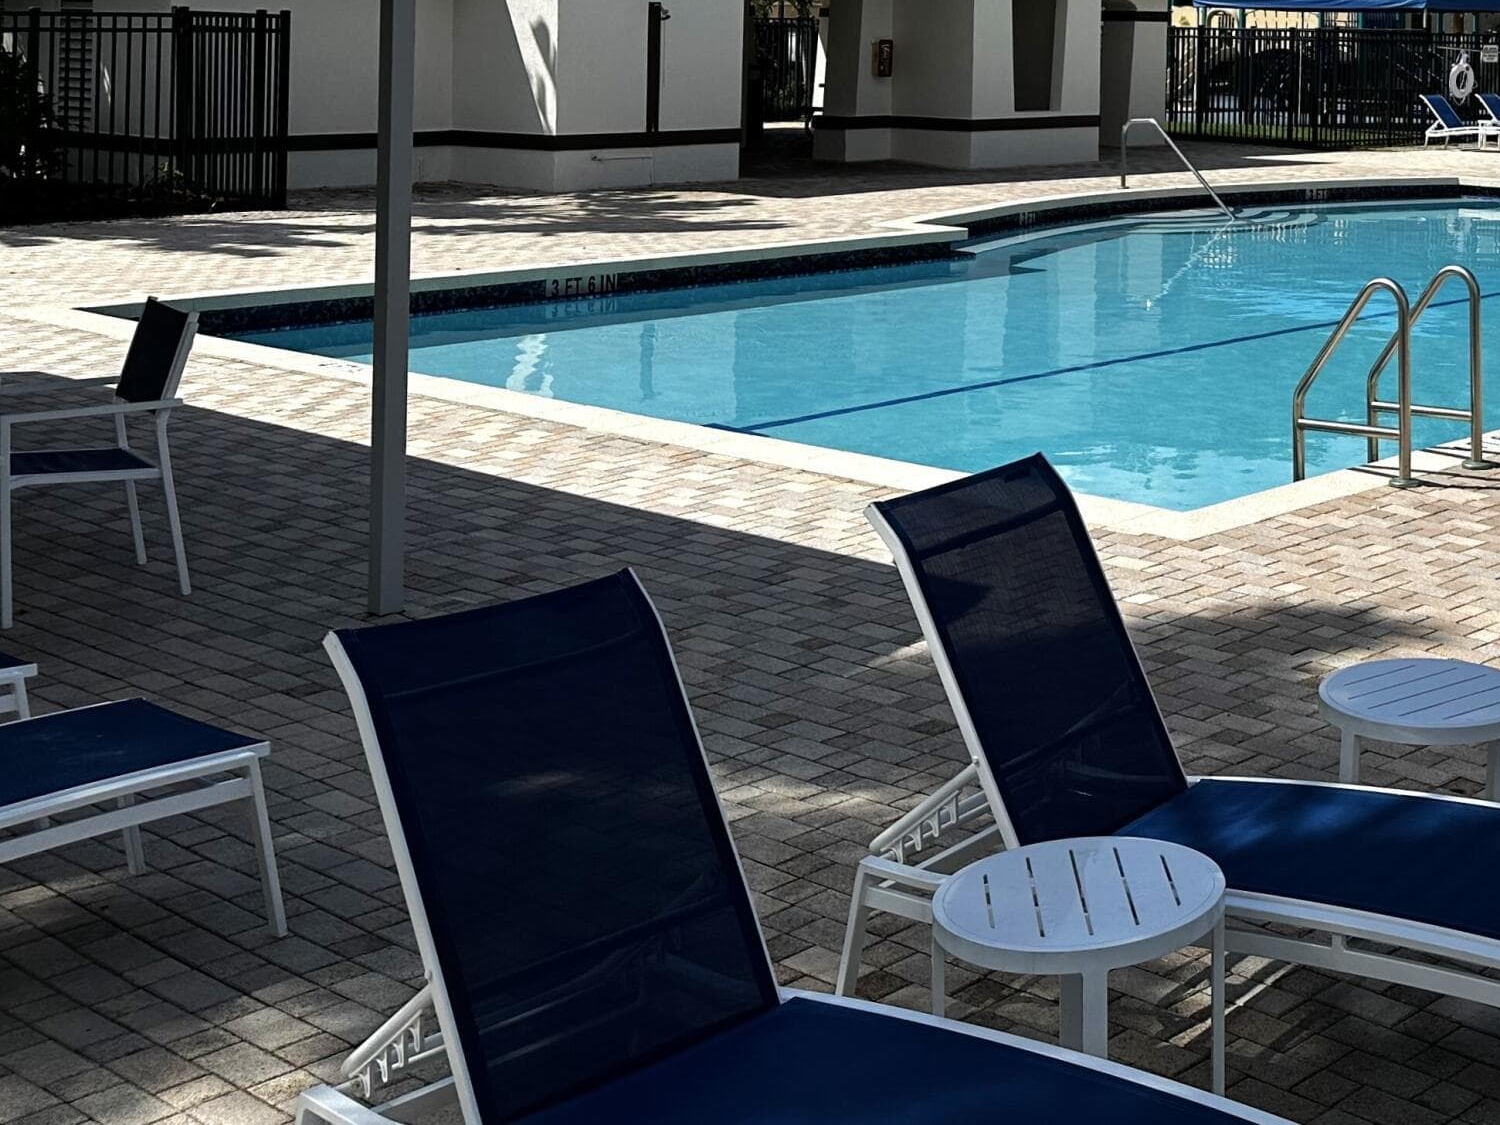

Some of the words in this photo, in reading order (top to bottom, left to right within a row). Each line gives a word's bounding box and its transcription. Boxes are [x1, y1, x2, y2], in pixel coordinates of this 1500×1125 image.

[551, 279, 559, 295] 3
[565, 277, 582, 295] FT
[588, 276, 596, 292] 6
[601, 273, 617, 292] IN
